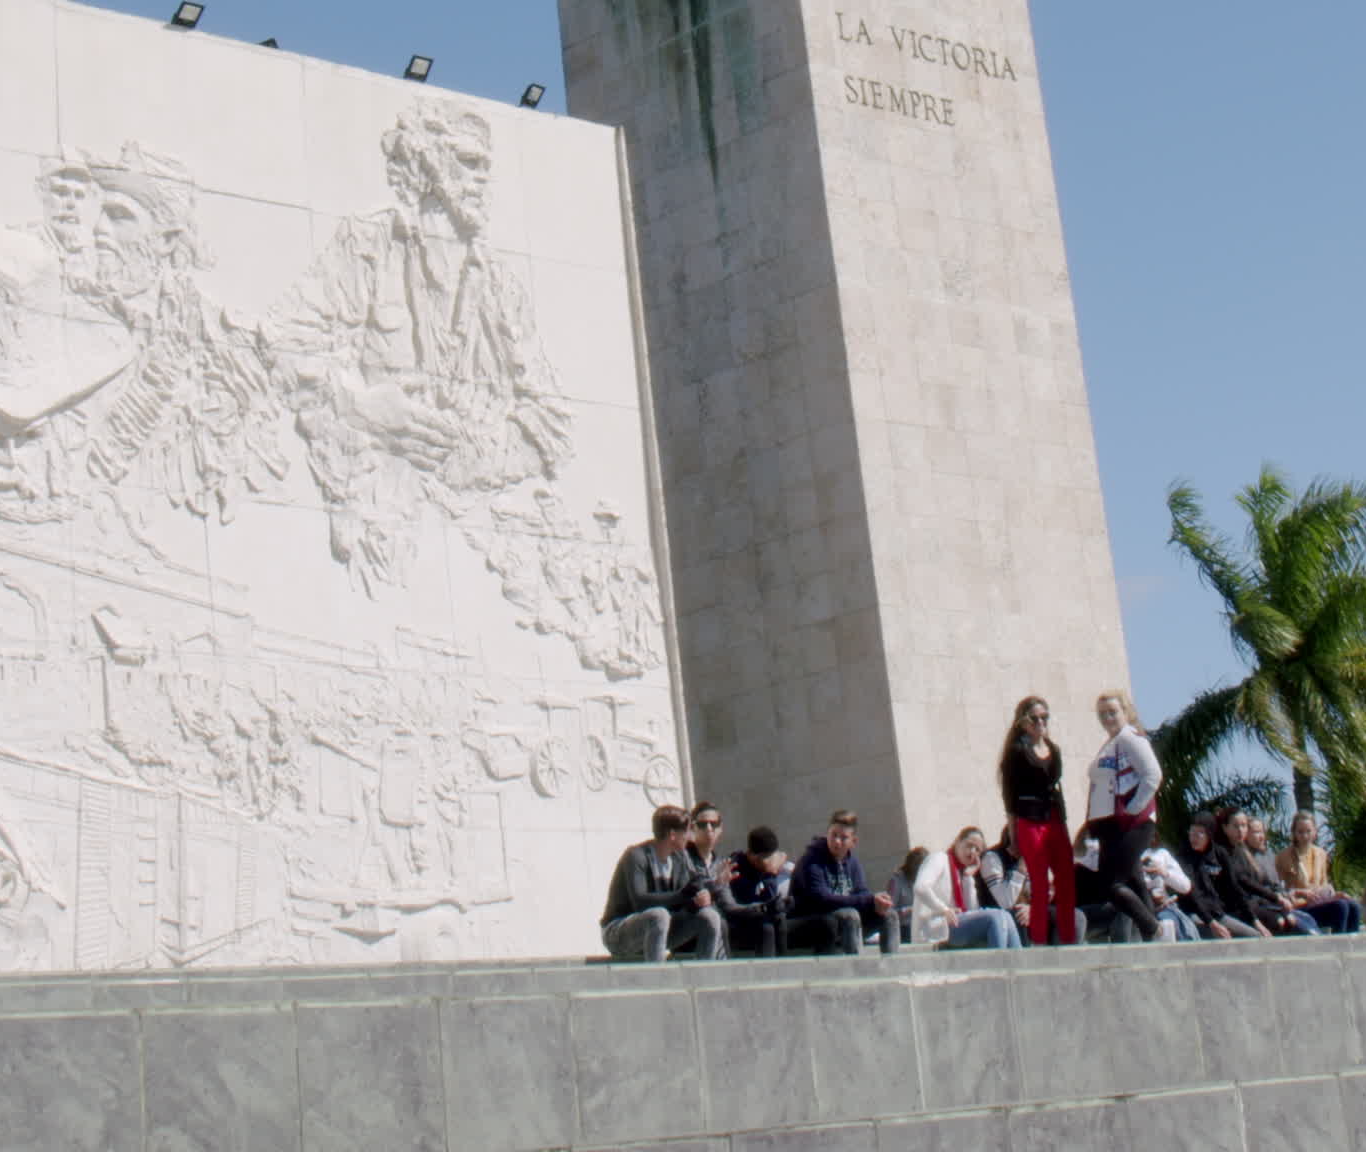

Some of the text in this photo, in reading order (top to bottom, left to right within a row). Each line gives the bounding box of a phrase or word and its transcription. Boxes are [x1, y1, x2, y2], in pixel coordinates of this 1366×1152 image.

[835, 12, 1018, 82] LA VICTORIA
[843, 74, 956, 127] SIEMPRE
